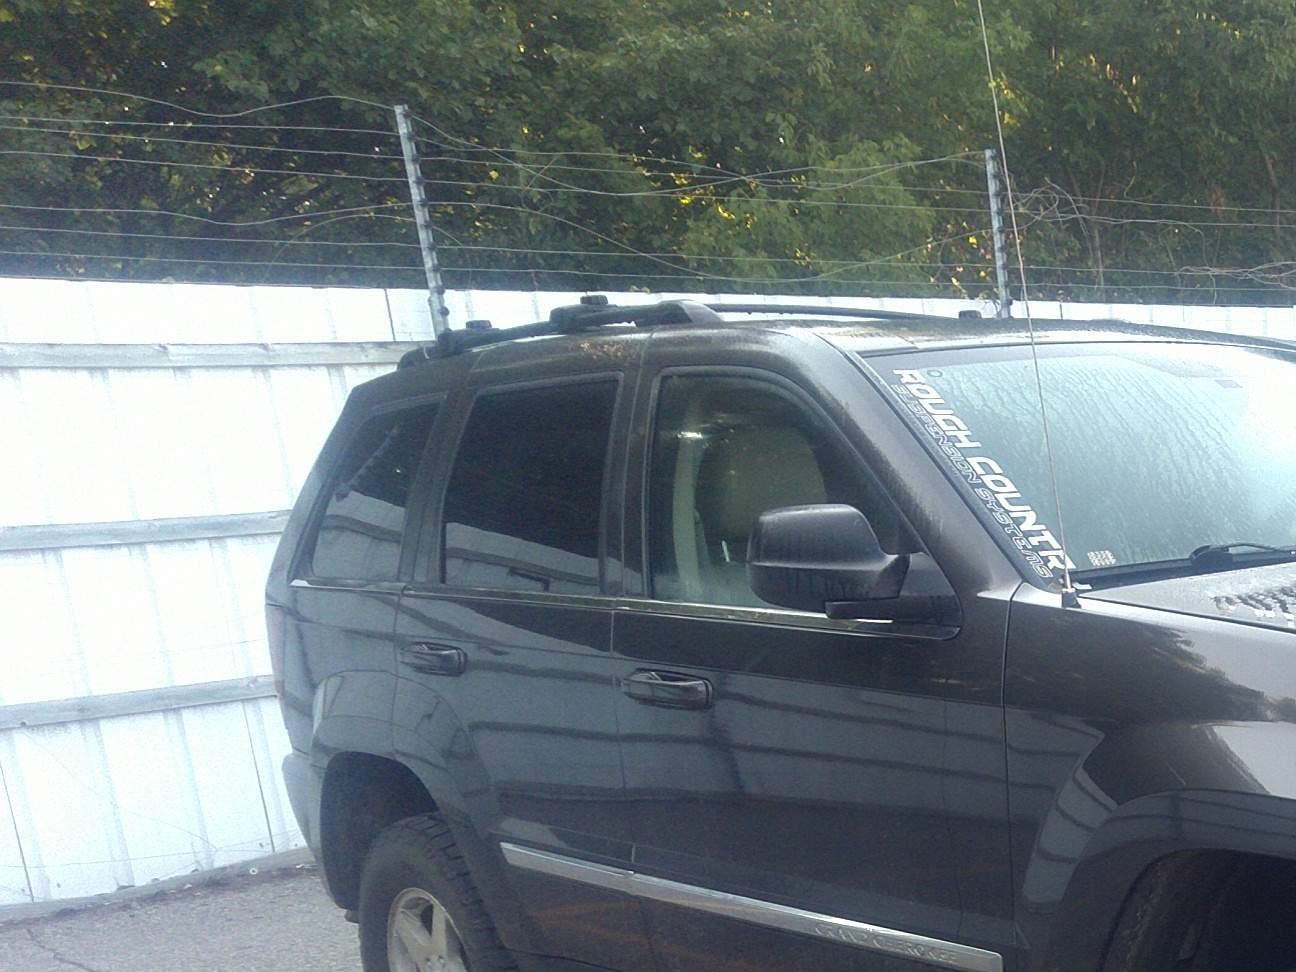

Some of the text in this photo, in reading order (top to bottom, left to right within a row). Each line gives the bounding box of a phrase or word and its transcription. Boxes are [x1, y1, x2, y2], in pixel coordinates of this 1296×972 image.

[893, 369, 982, 448] ROUGH
[891, 384, 1054, 578] SUSPENSION SYSTEMS
